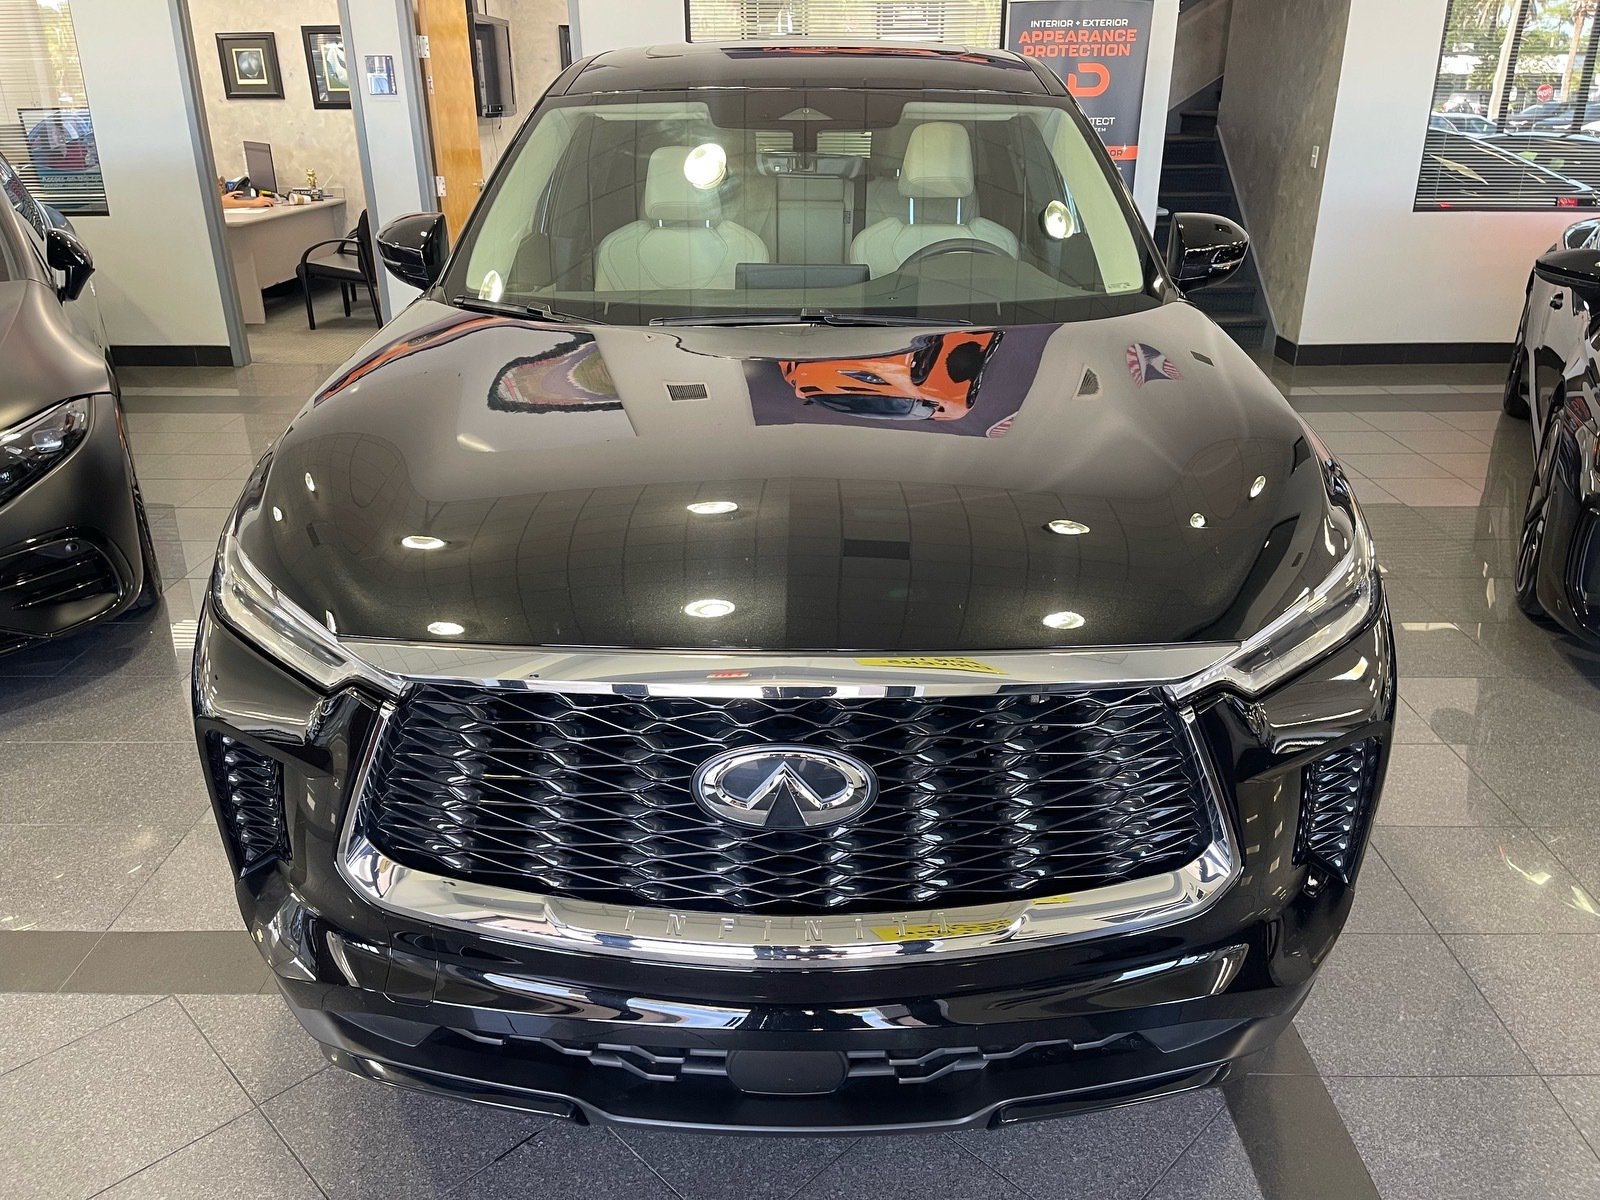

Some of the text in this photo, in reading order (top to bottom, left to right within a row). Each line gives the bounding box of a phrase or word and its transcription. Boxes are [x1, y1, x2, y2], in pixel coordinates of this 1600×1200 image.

[1030, 19, 1074, 28] INTERIOR
[1082, 18, 1129, 27] EXTERIOR
[1018, 29, 1138, 44] APPEARANCE
[1023, 44, 1131, 57] PROTECTION
[1108, 149, 1123, 157] OR
[623, 909, 949, 942] INFINITI
